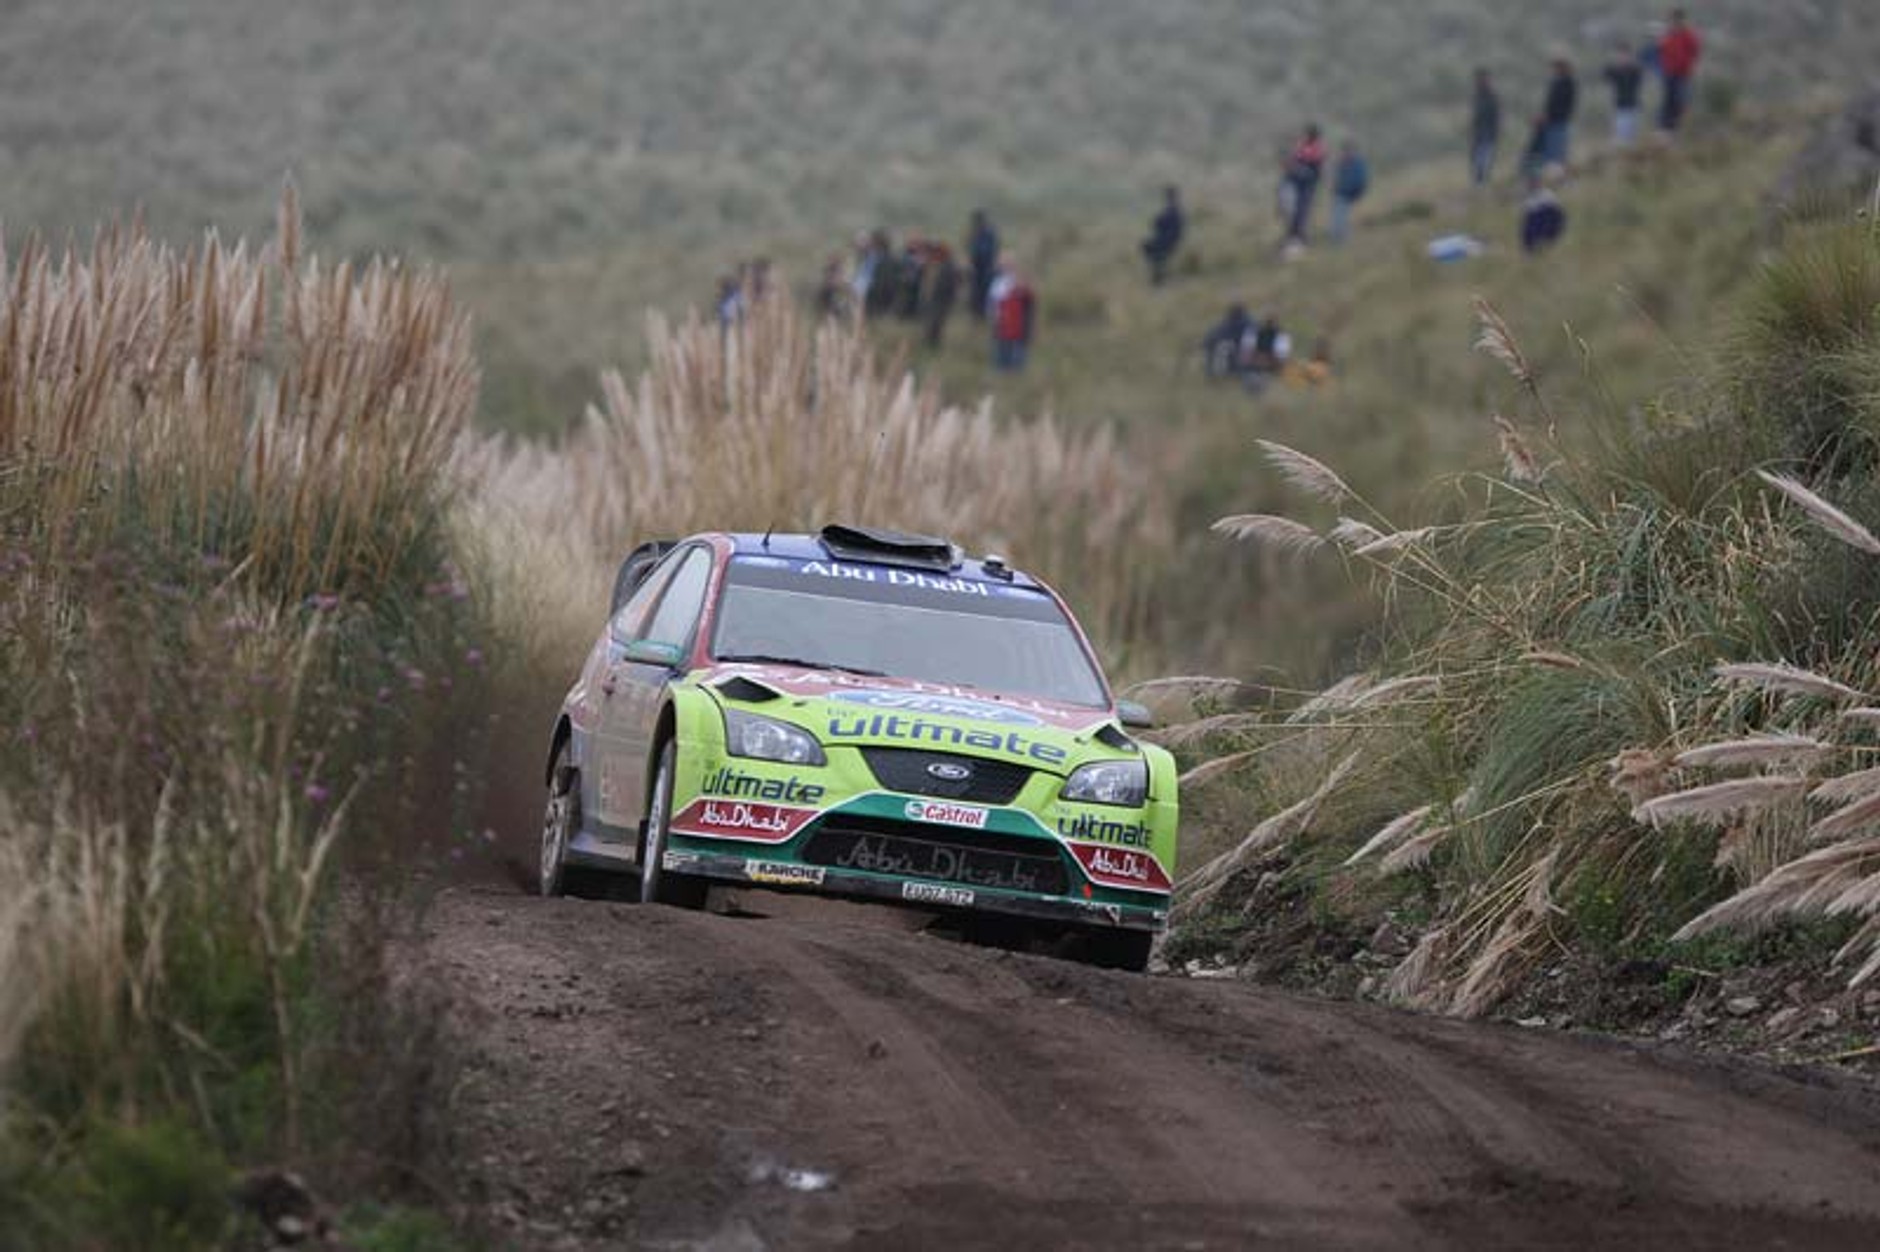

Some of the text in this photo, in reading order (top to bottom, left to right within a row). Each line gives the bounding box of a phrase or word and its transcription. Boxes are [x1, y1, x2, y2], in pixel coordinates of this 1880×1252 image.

[801, 561, 989, 596] Abu Dhabi
[829, 715, 1067, 765] ultimate
[702, 768, 825, 803] ultimate
[925, 805, 982, 825] Castrol
